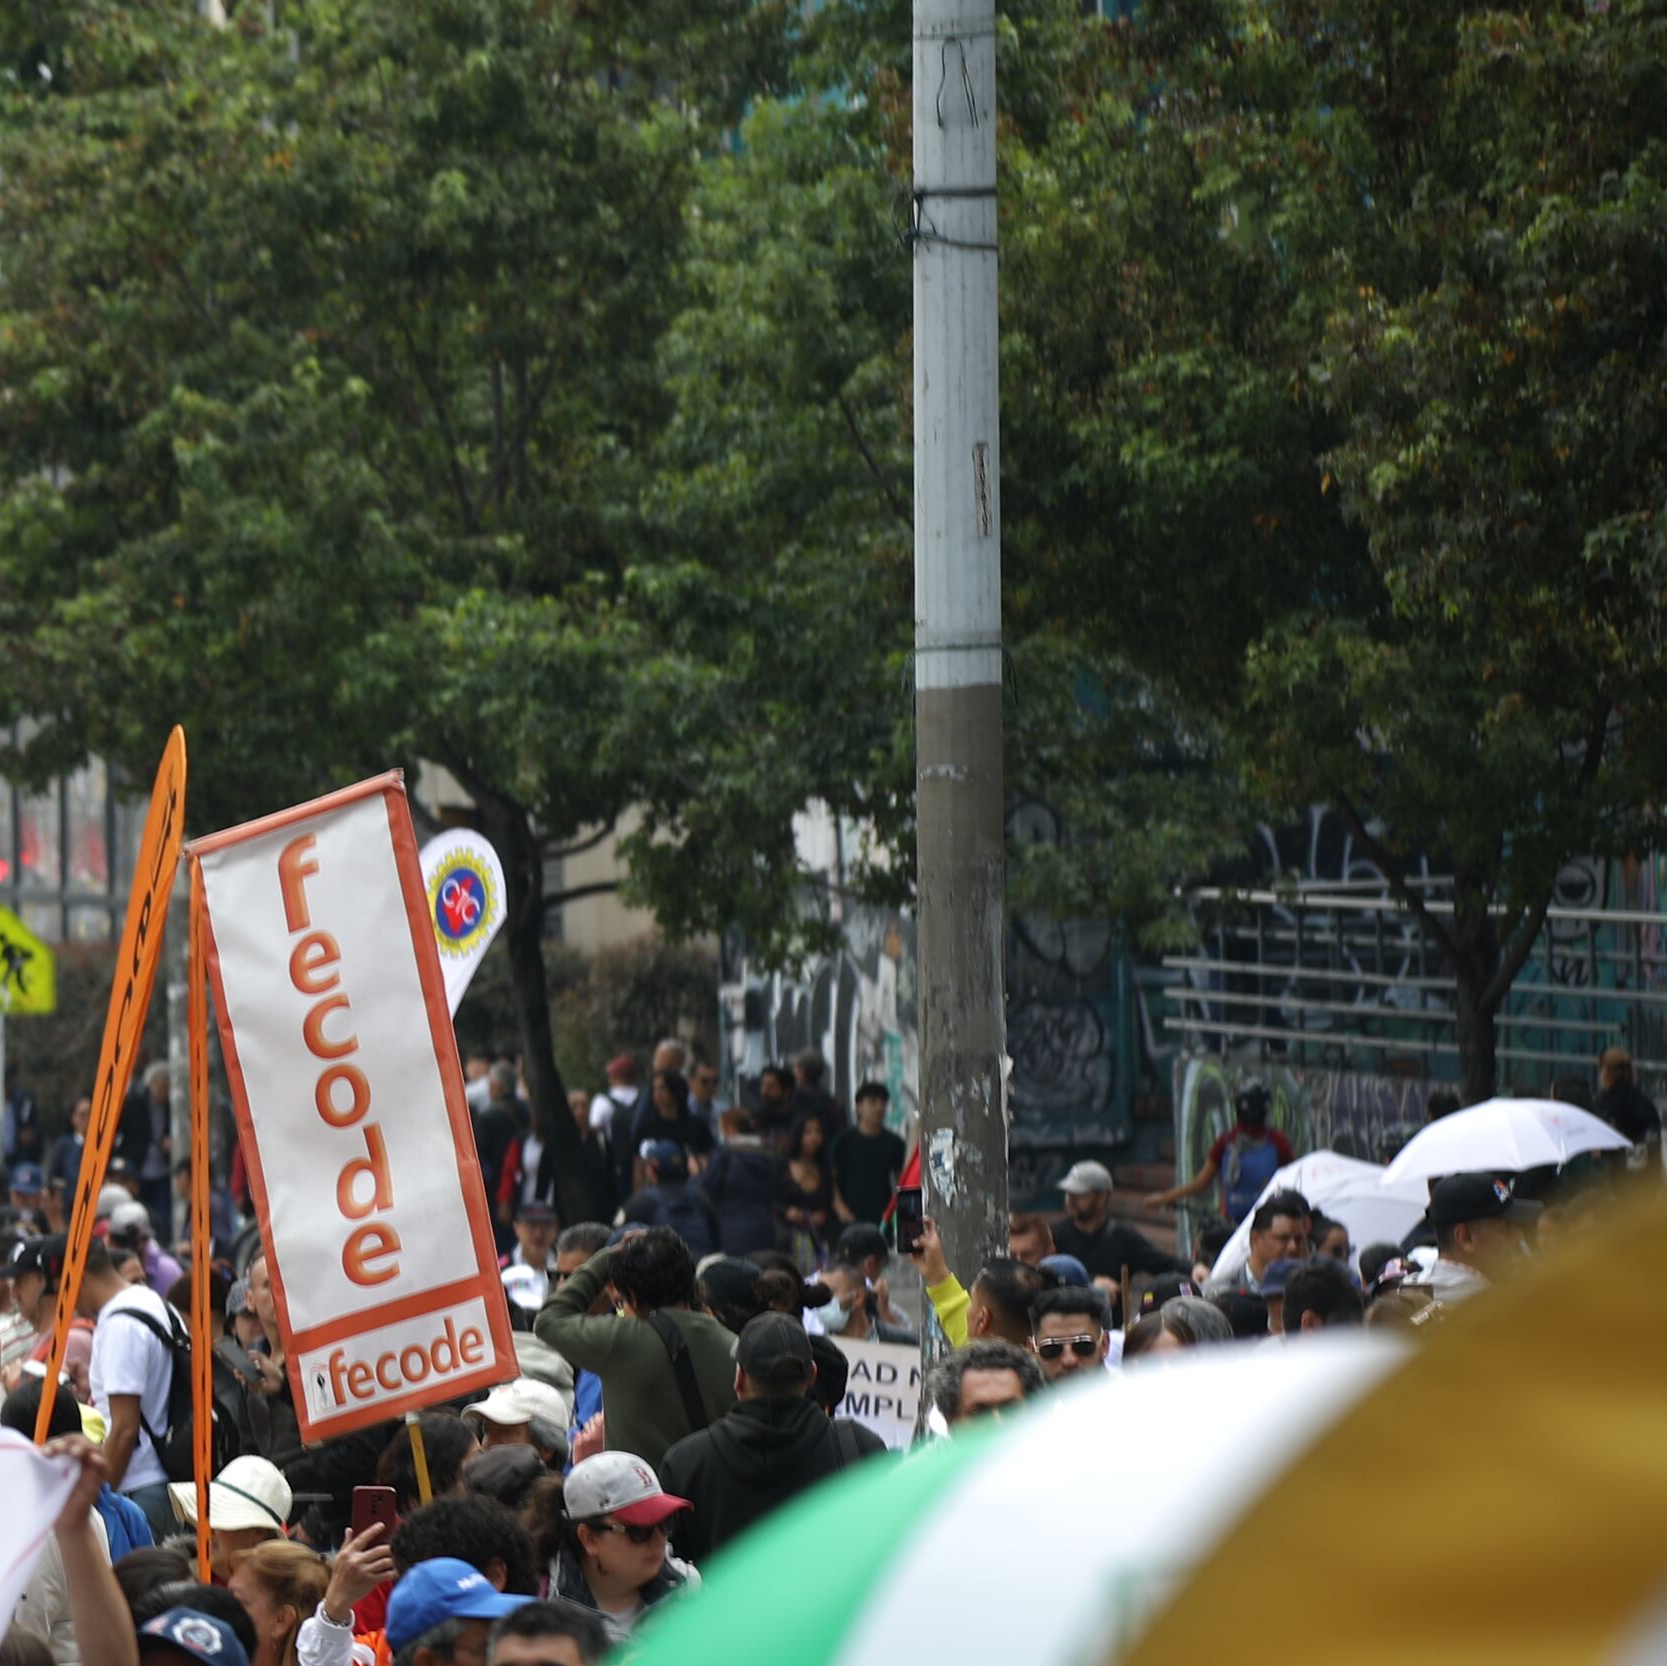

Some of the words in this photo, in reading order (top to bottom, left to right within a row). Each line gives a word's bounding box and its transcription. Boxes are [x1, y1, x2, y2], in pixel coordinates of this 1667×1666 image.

[276, 832, 403, 1289] fecode
[329, 1315, 485, 1407] fecode
[850, 1358, 898, 1385] AD
[844, 1390, 914, 1420] MPL
